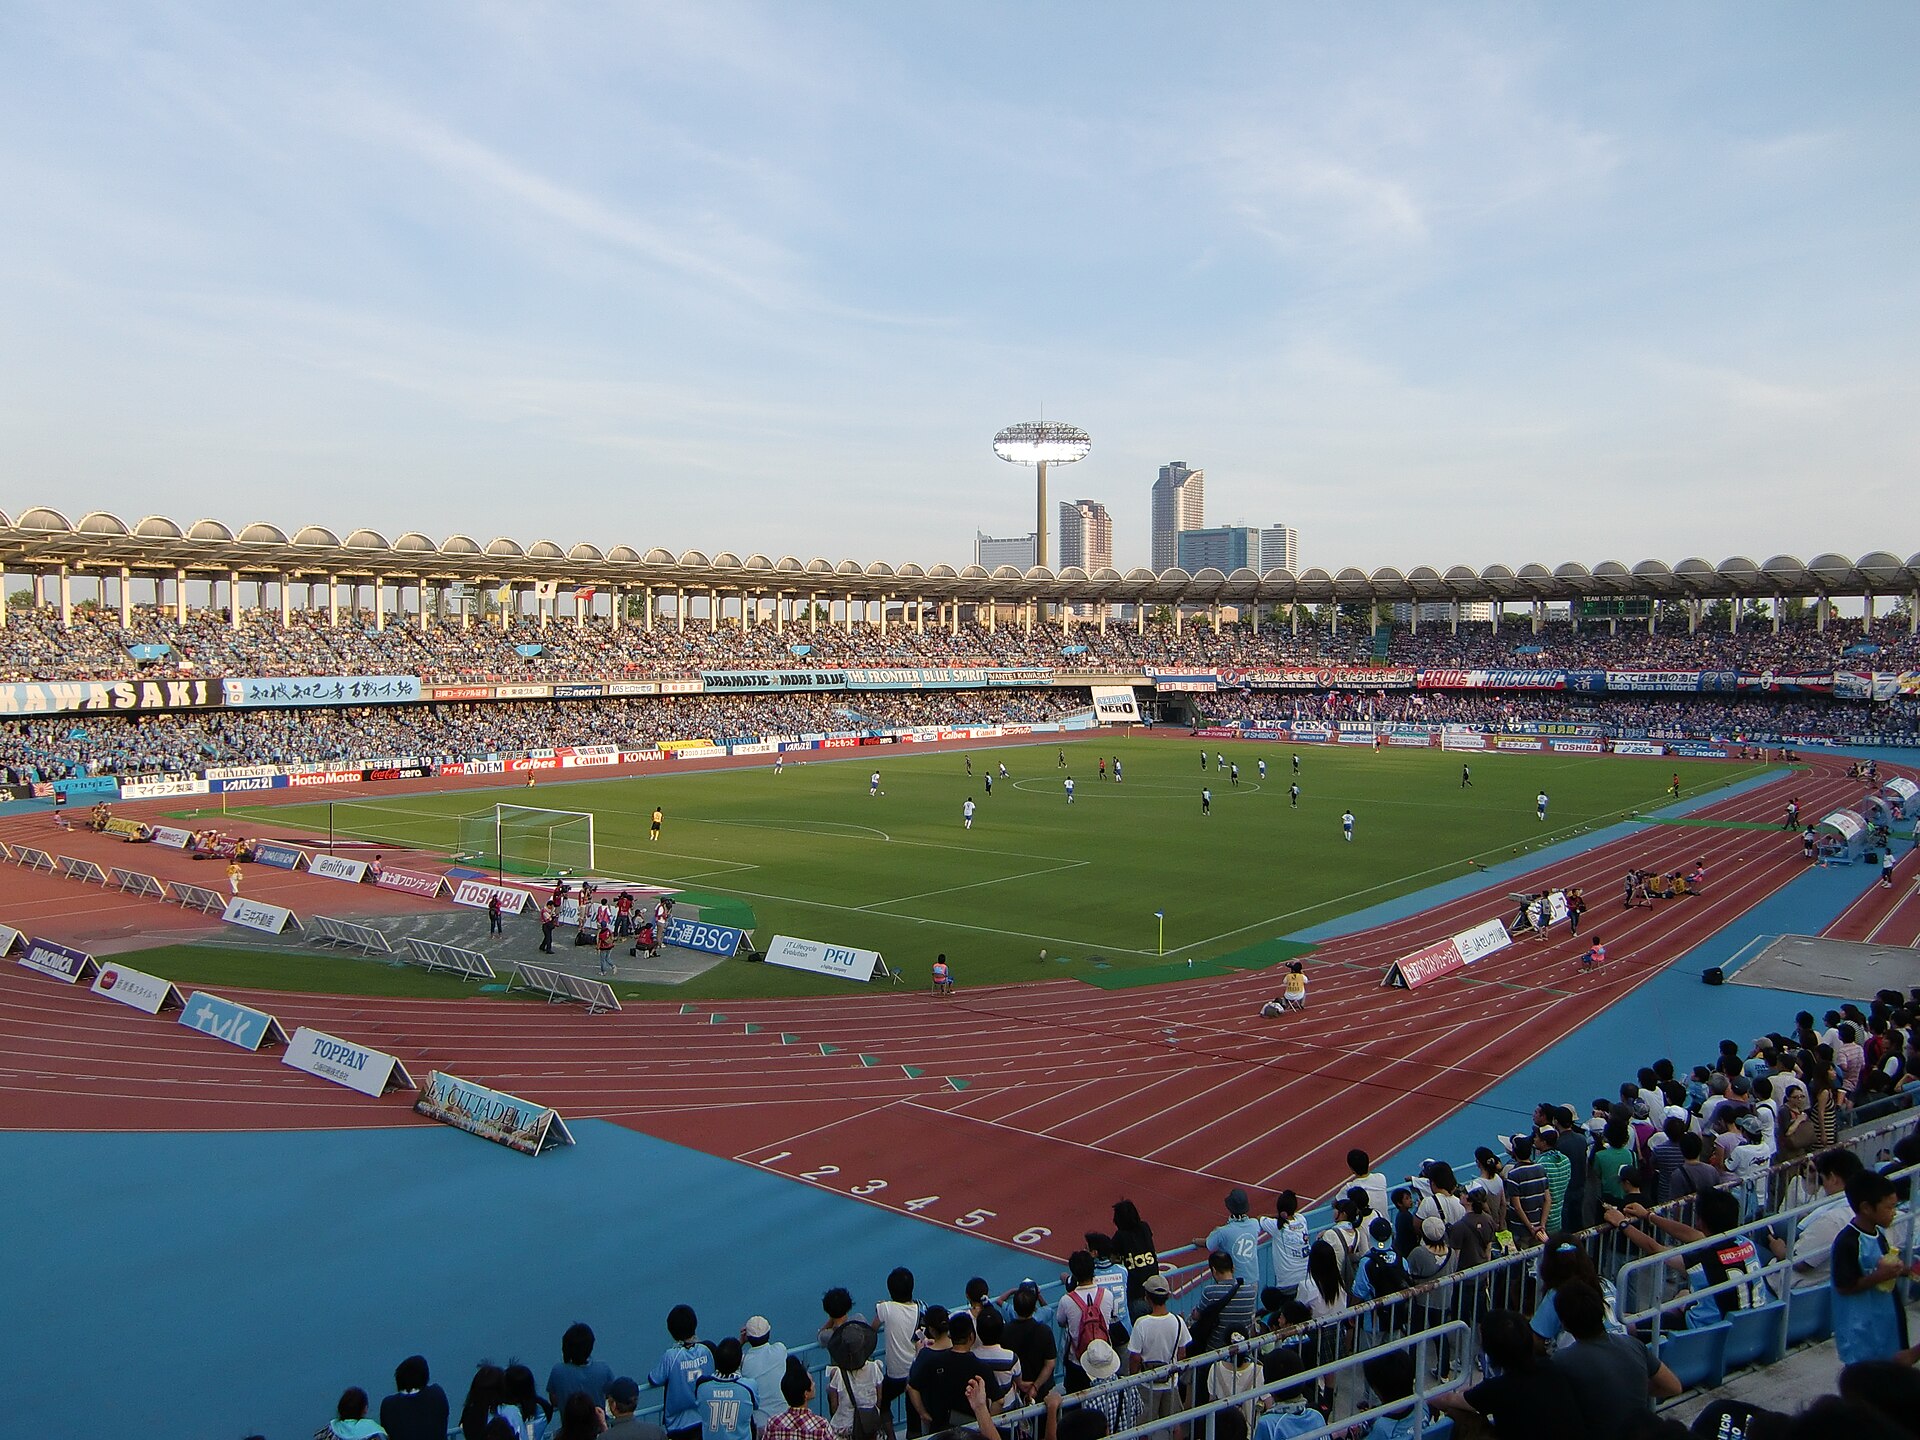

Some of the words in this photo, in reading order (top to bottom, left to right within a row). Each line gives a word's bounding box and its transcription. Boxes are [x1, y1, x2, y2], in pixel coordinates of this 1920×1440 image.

[706, 675, 771, 686] DRAMATIC
[779, 675, 813, 686] MORE
[815, 673, 846, 684] BLUE
[846, 671, 867, 683] THE
[868, 670, 921, 683] FRONTIER
[923, 670, 950, 682] BLUE
[953, 669, 985, 682] SPIRIT
[1248, 669, 1315, 682] 世界の果てまで
[1422, 670, 1471, 686] PRIDE
[1485, 670, 1561, 687] TRICOLOR
[0, 680, 208, 712] KAWASAKI
[573, 688, 601, 697] nocria
[941, 731, 967, 740] Calbee
[976, 729, 997, 737] Canon
[824, 739, 855, 748] ほっともっと
[1556, 743, 1599, 752] TOSHIBA
[574, 755, 609, 765] Canon
[623, 751, 665, 763] KONAMI
[1696, 749, 1726, 757] nocria
[512, 759, 556, 771] Calbee
[217, 769, 266, 778] CHALLENGE
[138, 784, 194, 795] マイラン製薬
[222, 776, 273, 791] レオパレス21
[319, 859, 347, 876] @nifty
[380, 871, 439, 892] 富士通フロンテック
[241, 908, 276, 928] 三井不動産
[782, 947, 808, 957] Evolution
[792, 942, 818, 952] Lifecycle
[823, 948, 856, 966] PFU
[194, 1002, 251, 1048] tvk
[312, 1038, 370, 1071] TOPPAN
[426, 1080, 446, 1102] LA
[447, 1087, 541, 1136] CITTADELLA
[759, 1151, 793, 1166] 1
[800, 1165, 840, 1181] 2
[851, 1179, 888, 1195] 3
[903, 1195, 941, 1212] 4
[955, 1208, 998, 1228] 5
[1012, 1226, 1052, 1245] 6
[1235, 1238, 1254, 1258] 12
[713, 1390, 734, 1398] KENGO
[707, 1400, 741, 1432] 14
